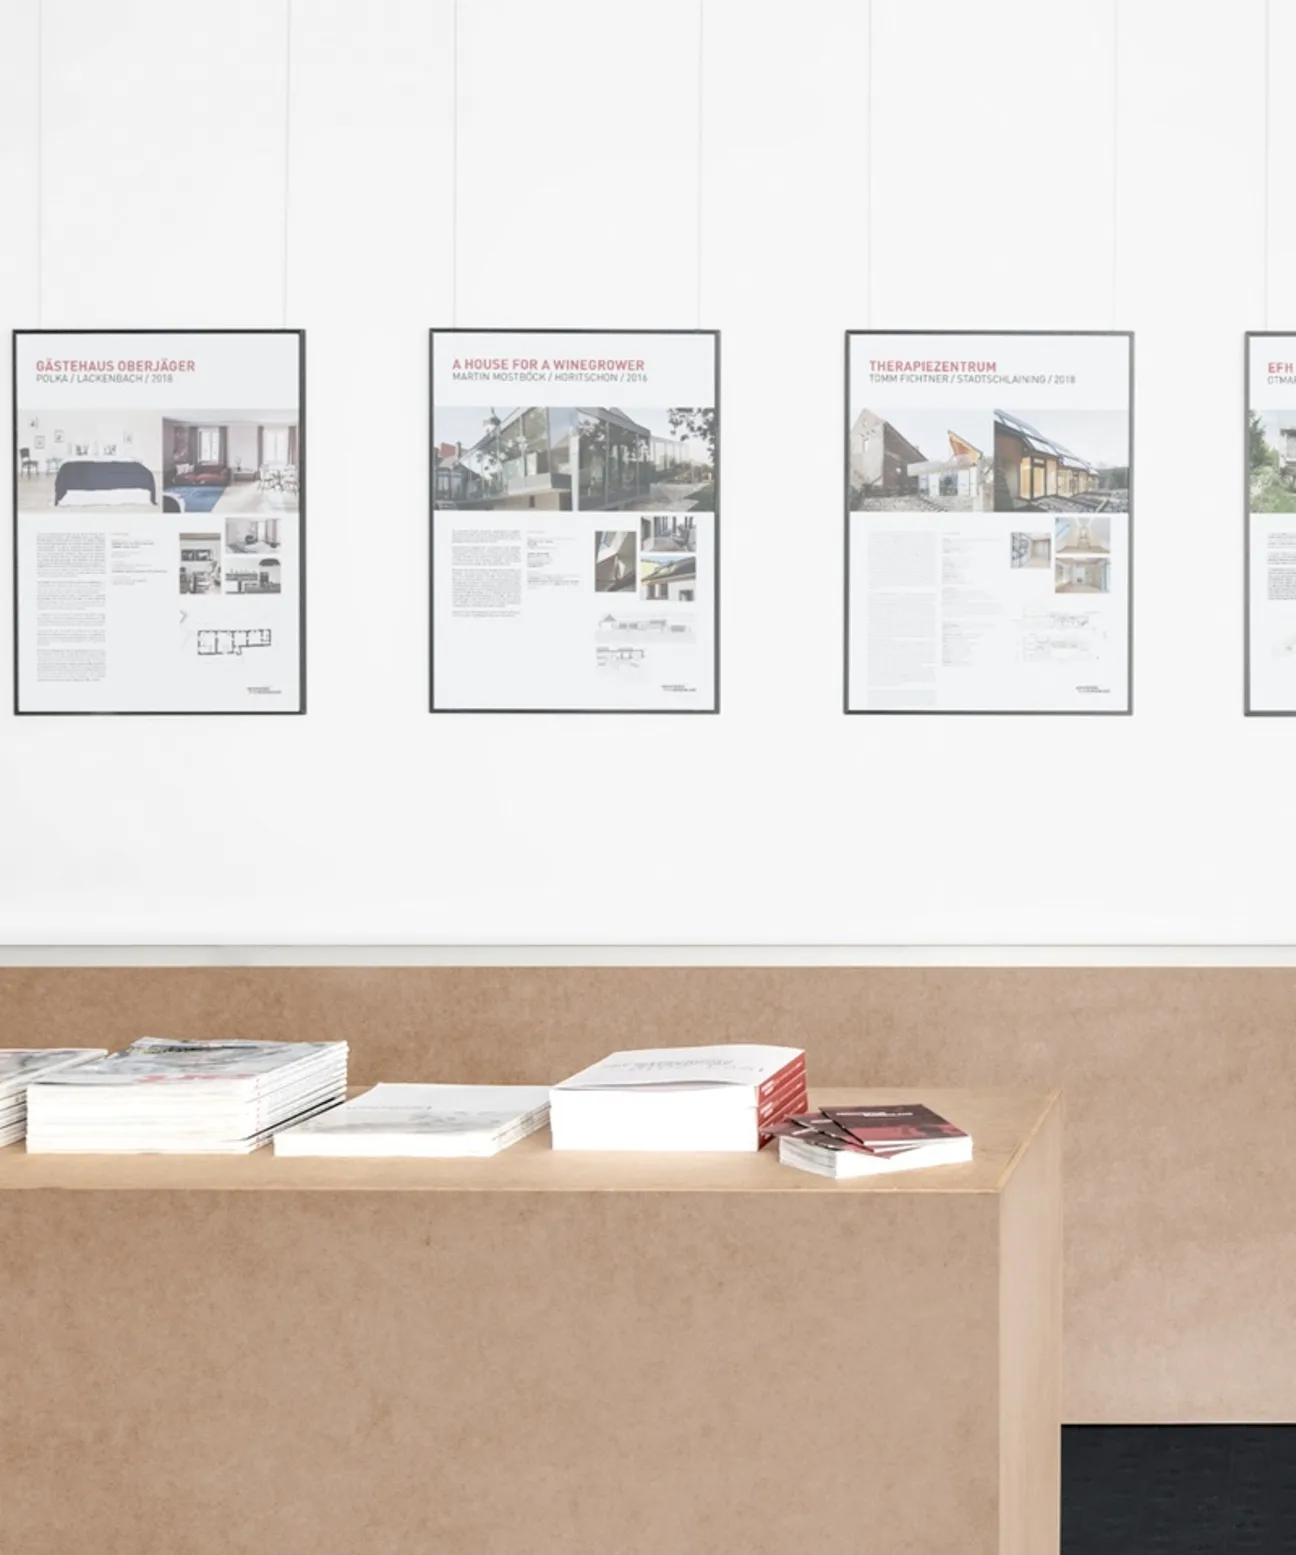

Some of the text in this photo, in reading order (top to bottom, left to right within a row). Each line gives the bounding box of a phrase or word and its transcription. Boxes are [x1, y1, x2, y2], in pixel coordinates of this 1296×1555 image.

[36, 358, 195, 372] GÄSTEHAUS OBERJÄGER
[452, 359, 645, 371] A HOUSE FOR A WINEGROWER
[869, 360, 997, 372] THERAPIEZENTRUM
[1267, 362, 1294, 374] EFH
[36, 374, 68, 384] POLKA
[76, 374, 143, 384] LACKENBACH
[151, 374, 174, 384] 2018
[452, 372, 490, 382] MARTIN
[554, 372, 619, 382] HORITSCHON
[626, 373, 648, 383] 2016
[869, 373, 898, 384] TOMM
[900, 373, 949, 384] FICHTNER
[957, 374, 1046, 384] STADTSCHLAINING
